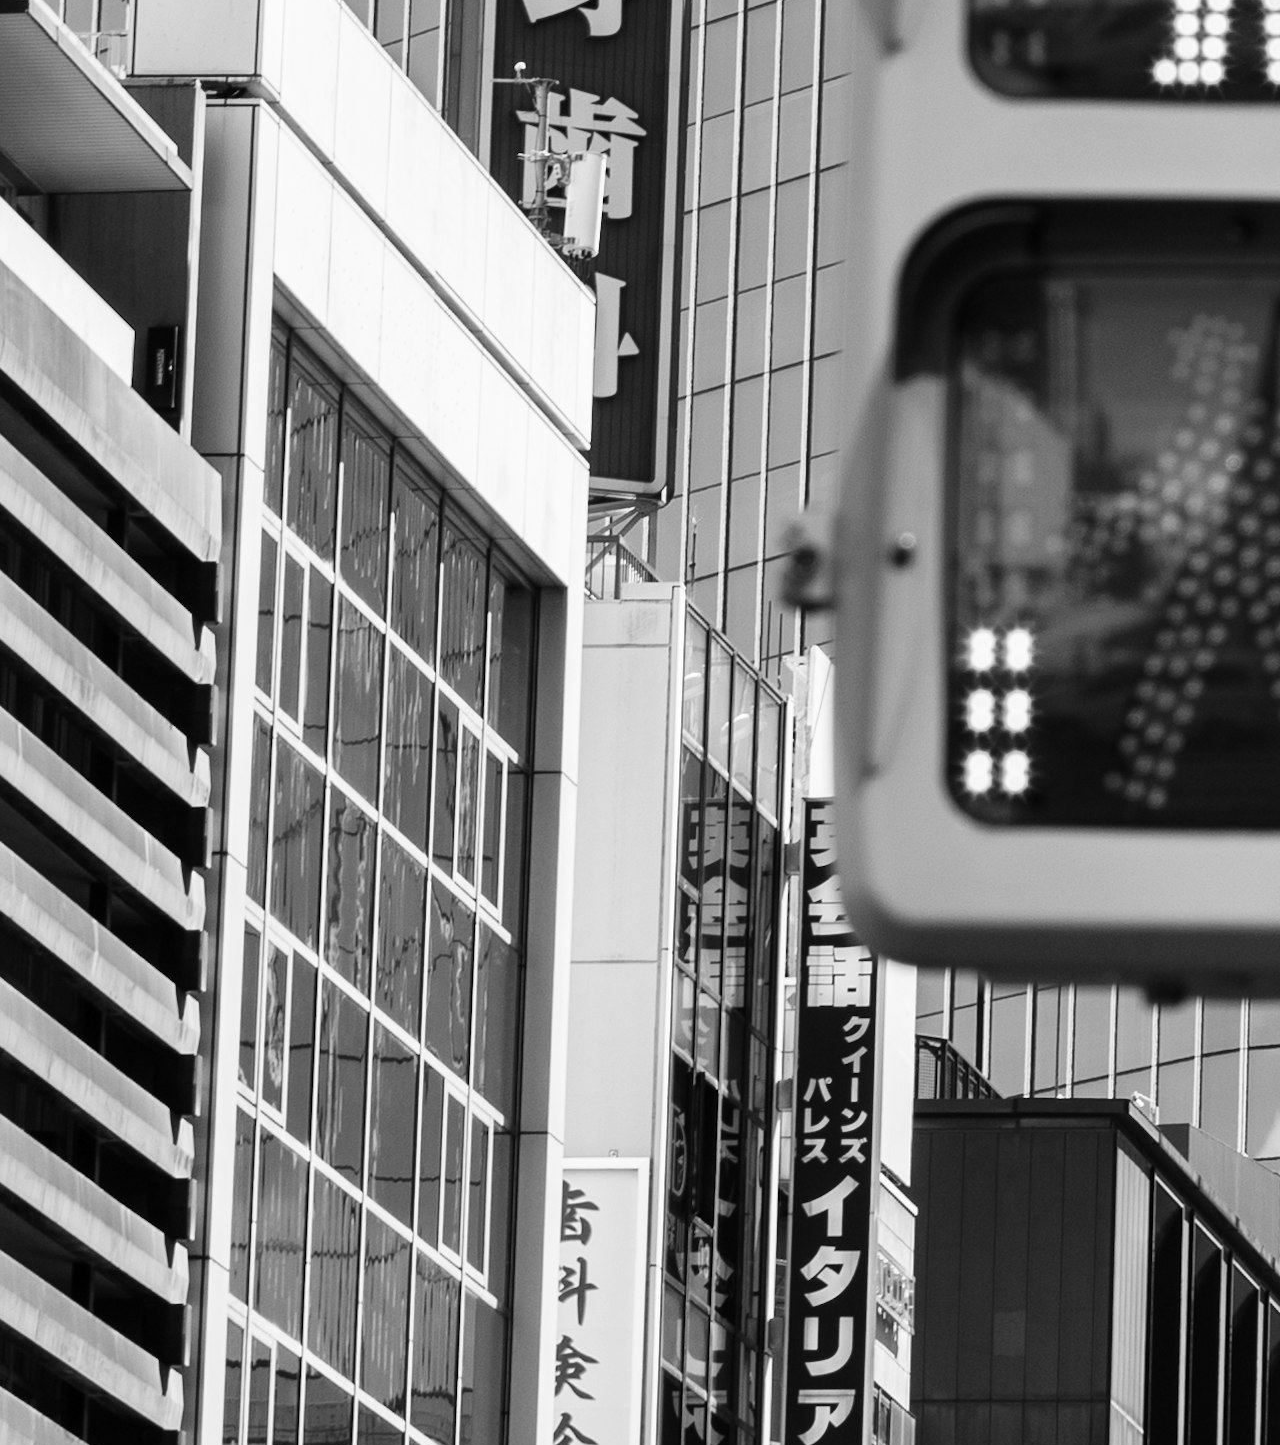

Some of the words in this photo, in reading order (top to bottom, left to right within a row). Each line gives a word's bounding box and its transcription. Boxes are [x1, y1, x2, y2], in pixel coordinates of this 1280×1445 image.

[802, 1075, 833, 1164] パレス
[841, 1015, 872, 1164] クイーンズ
